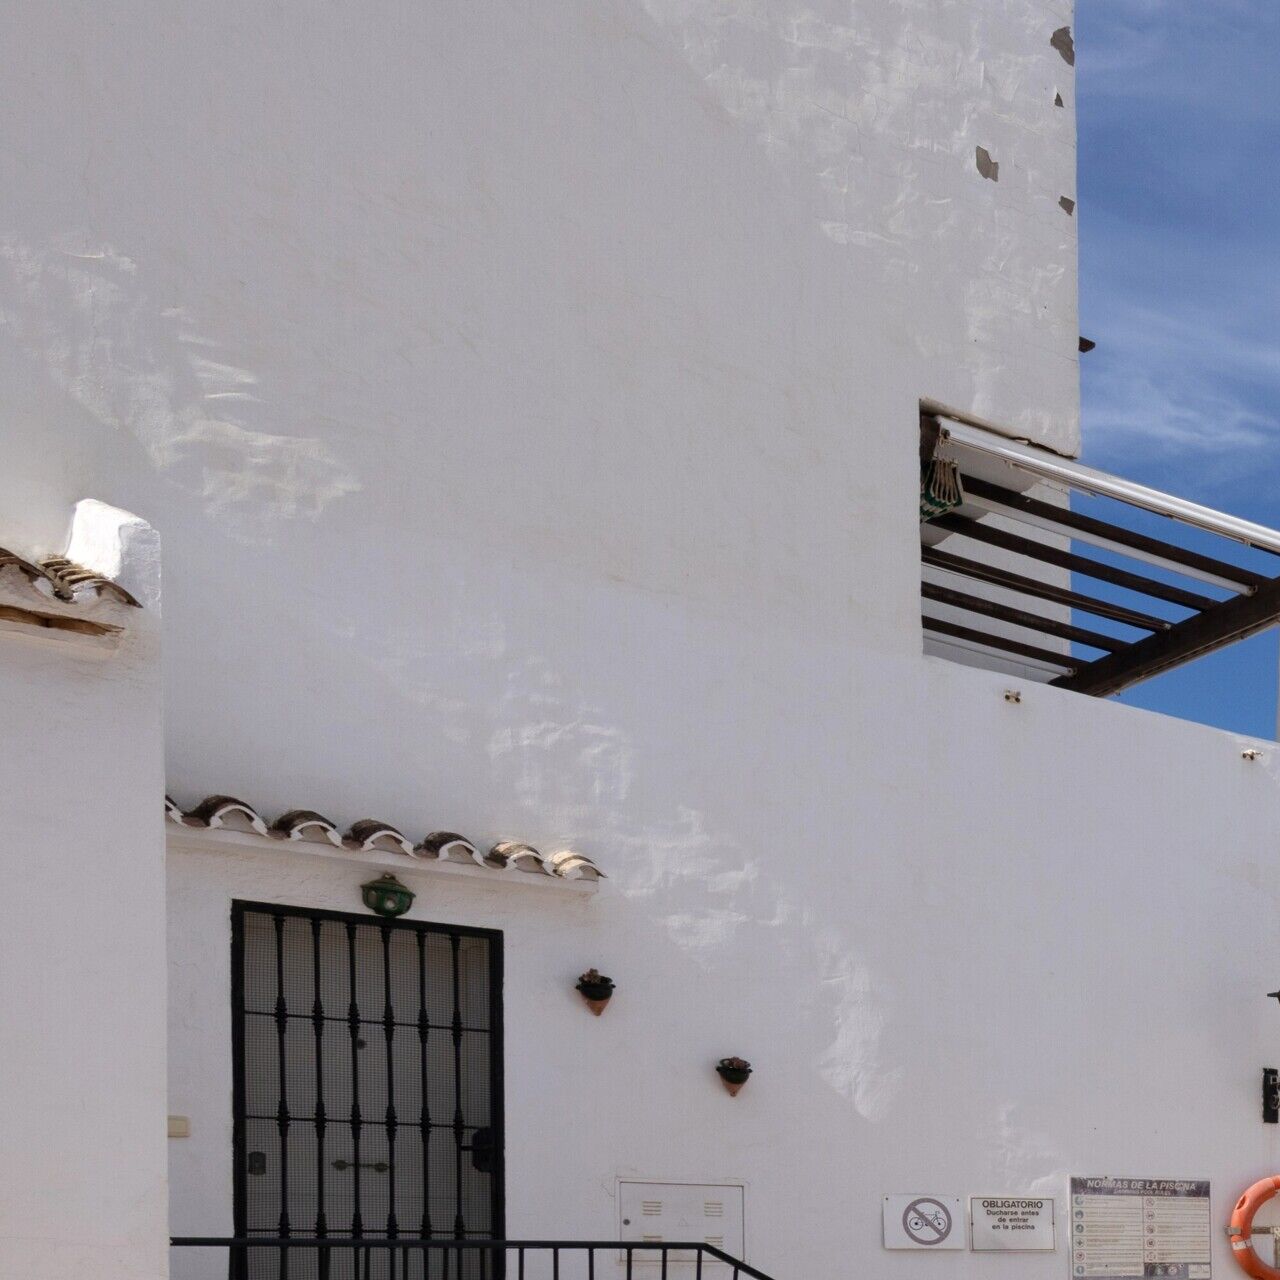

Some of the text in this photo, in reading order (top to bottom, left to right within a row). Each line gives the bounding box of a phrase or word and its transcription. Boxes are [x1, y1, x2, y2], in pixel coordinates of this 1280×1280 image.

[1087, 1180, 1197, 1191] NORMAS DE LA PISCINA
[982, 1200, 1043, 1209] OBLIGATORIO
